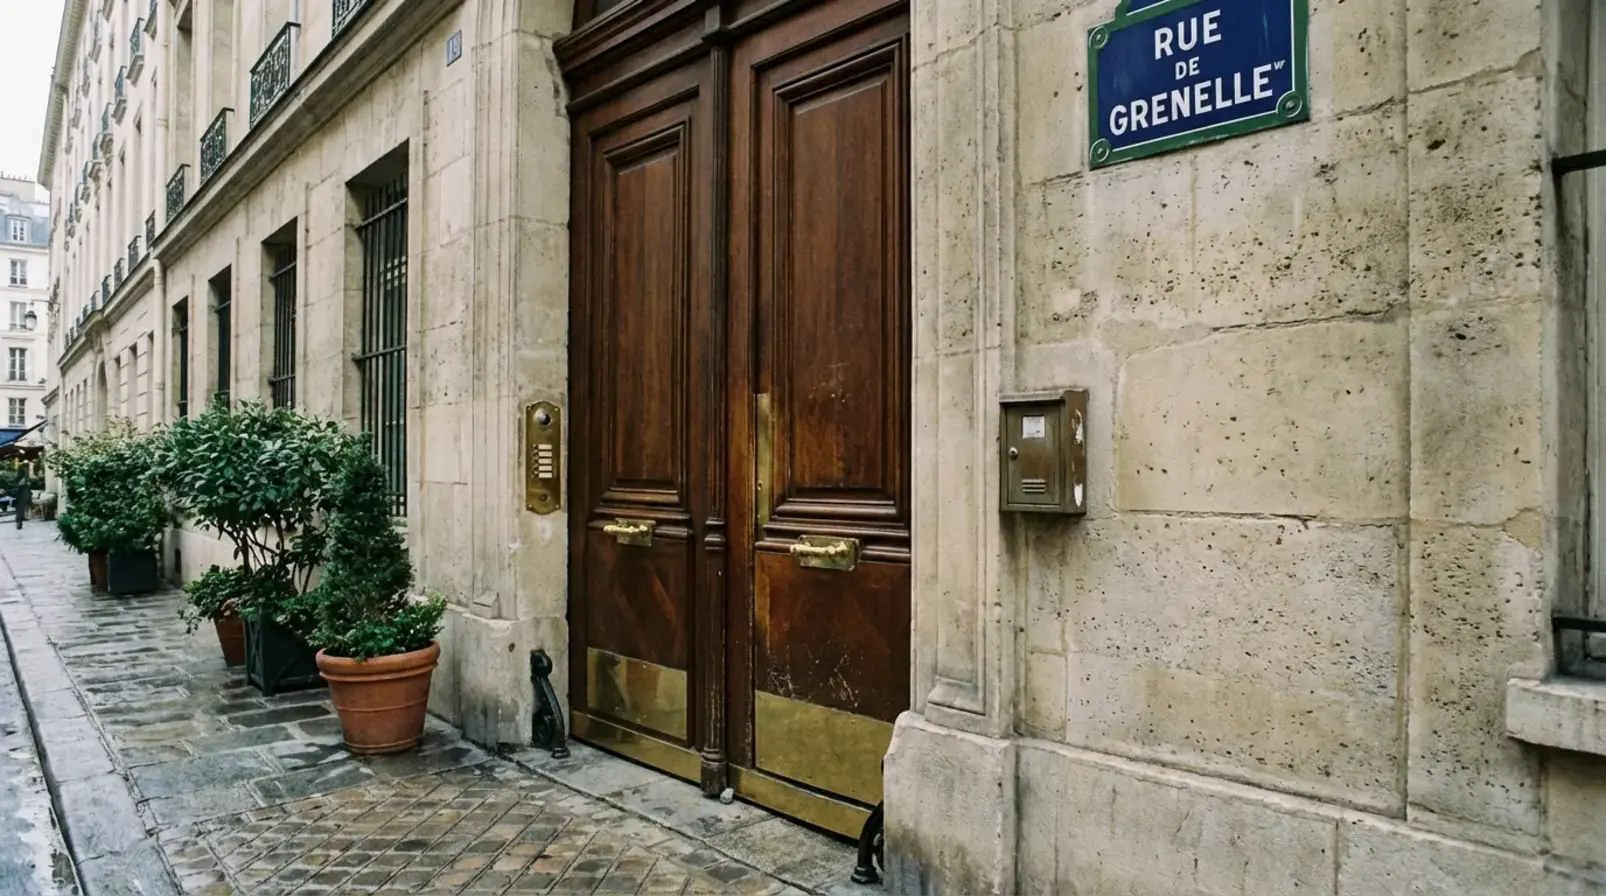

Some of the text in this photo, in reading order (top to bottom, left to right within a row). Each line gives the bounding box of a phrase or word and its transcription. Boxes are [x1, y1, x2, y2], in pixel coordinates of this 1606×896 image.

[1154, 9, 1222, 60] RUE
[1175, 56, 1200, 80] DE
[1109, 63, 1273, 136] GRENELLE
